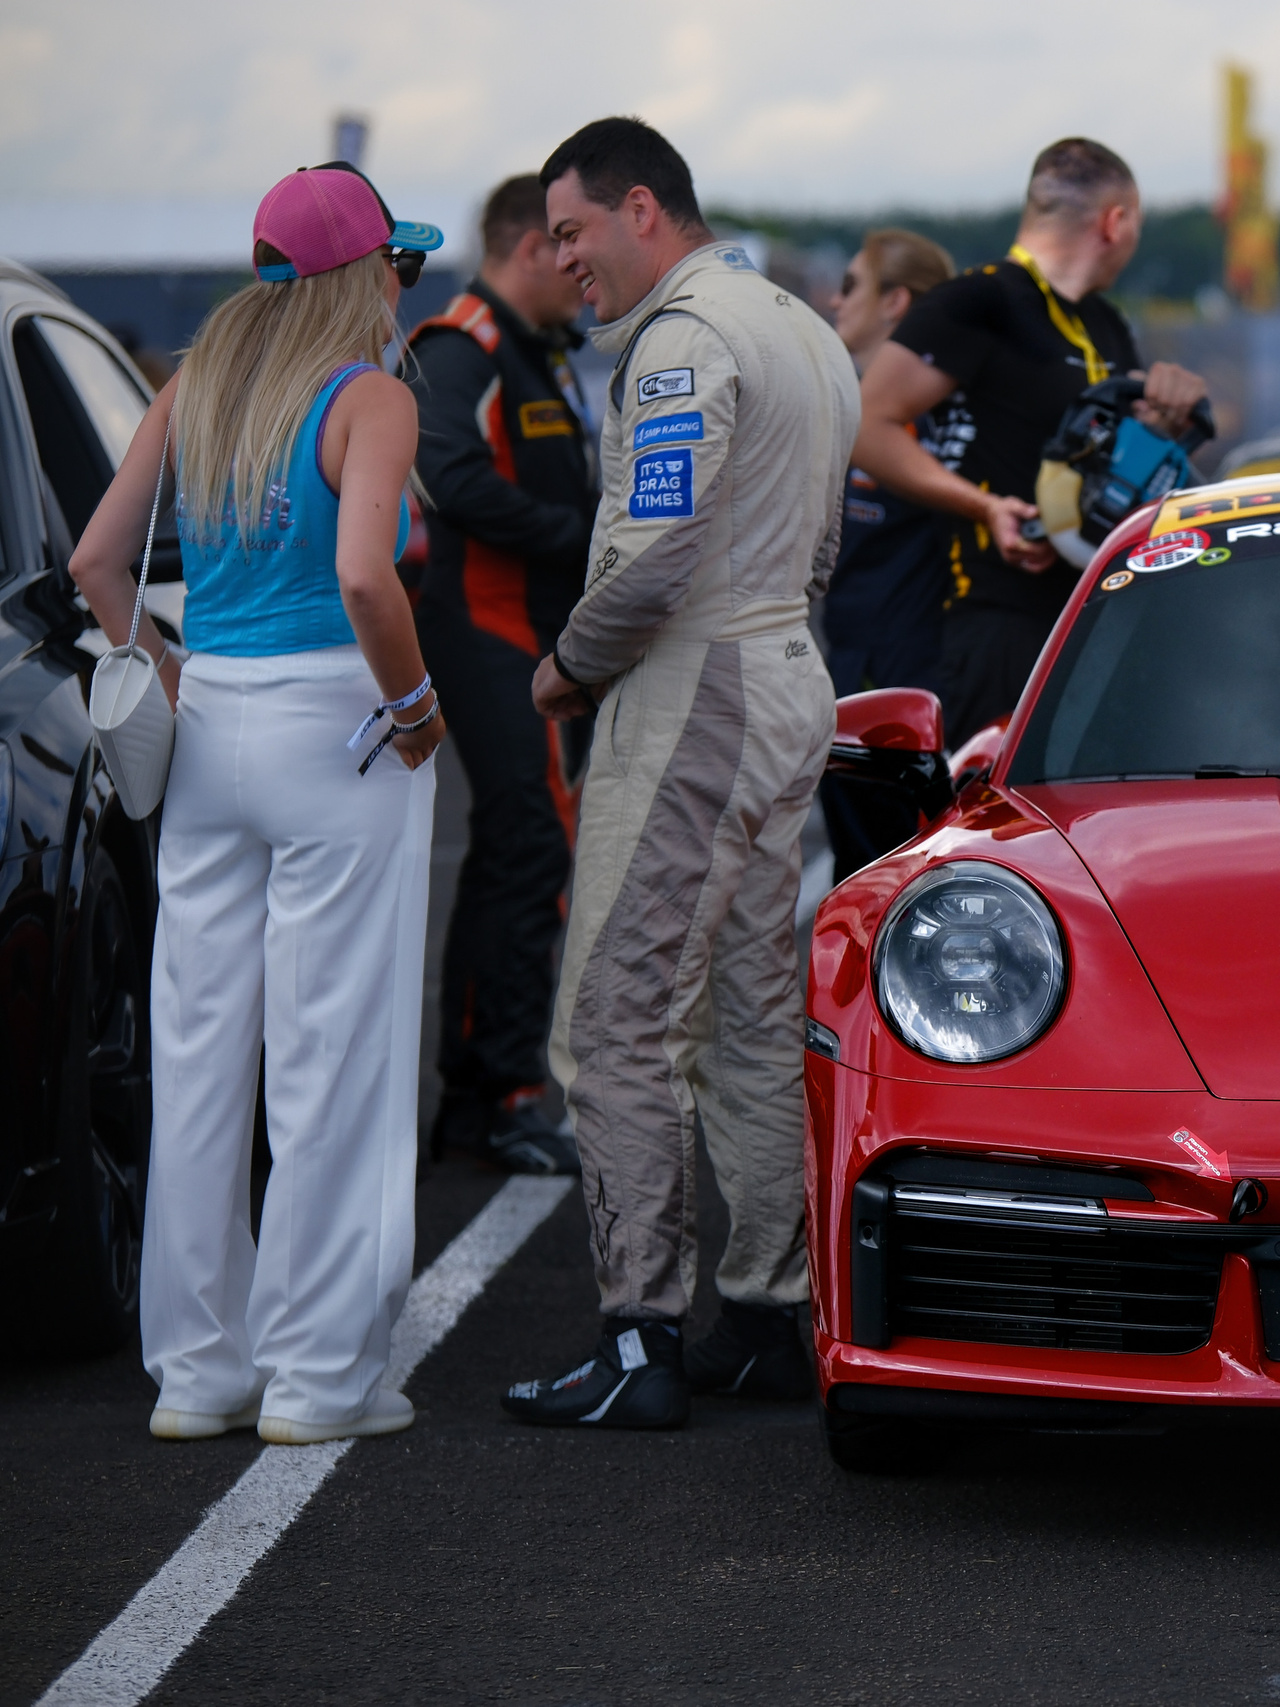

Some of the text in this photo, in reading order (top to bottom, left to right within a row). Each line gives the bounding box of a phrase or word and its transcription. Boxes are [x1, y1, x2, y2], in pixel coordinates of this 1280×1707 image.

[643, 421, 700, 439] SMP RACING
[640, 461, 664, 477] IT'S
[638, 476, 681, 492] DRAG
[635, 492, 683, 508] TIMES
[1189, 1137, 1208, 1155] Ramon
[1183, 1141, 1221, 1177] Performance
